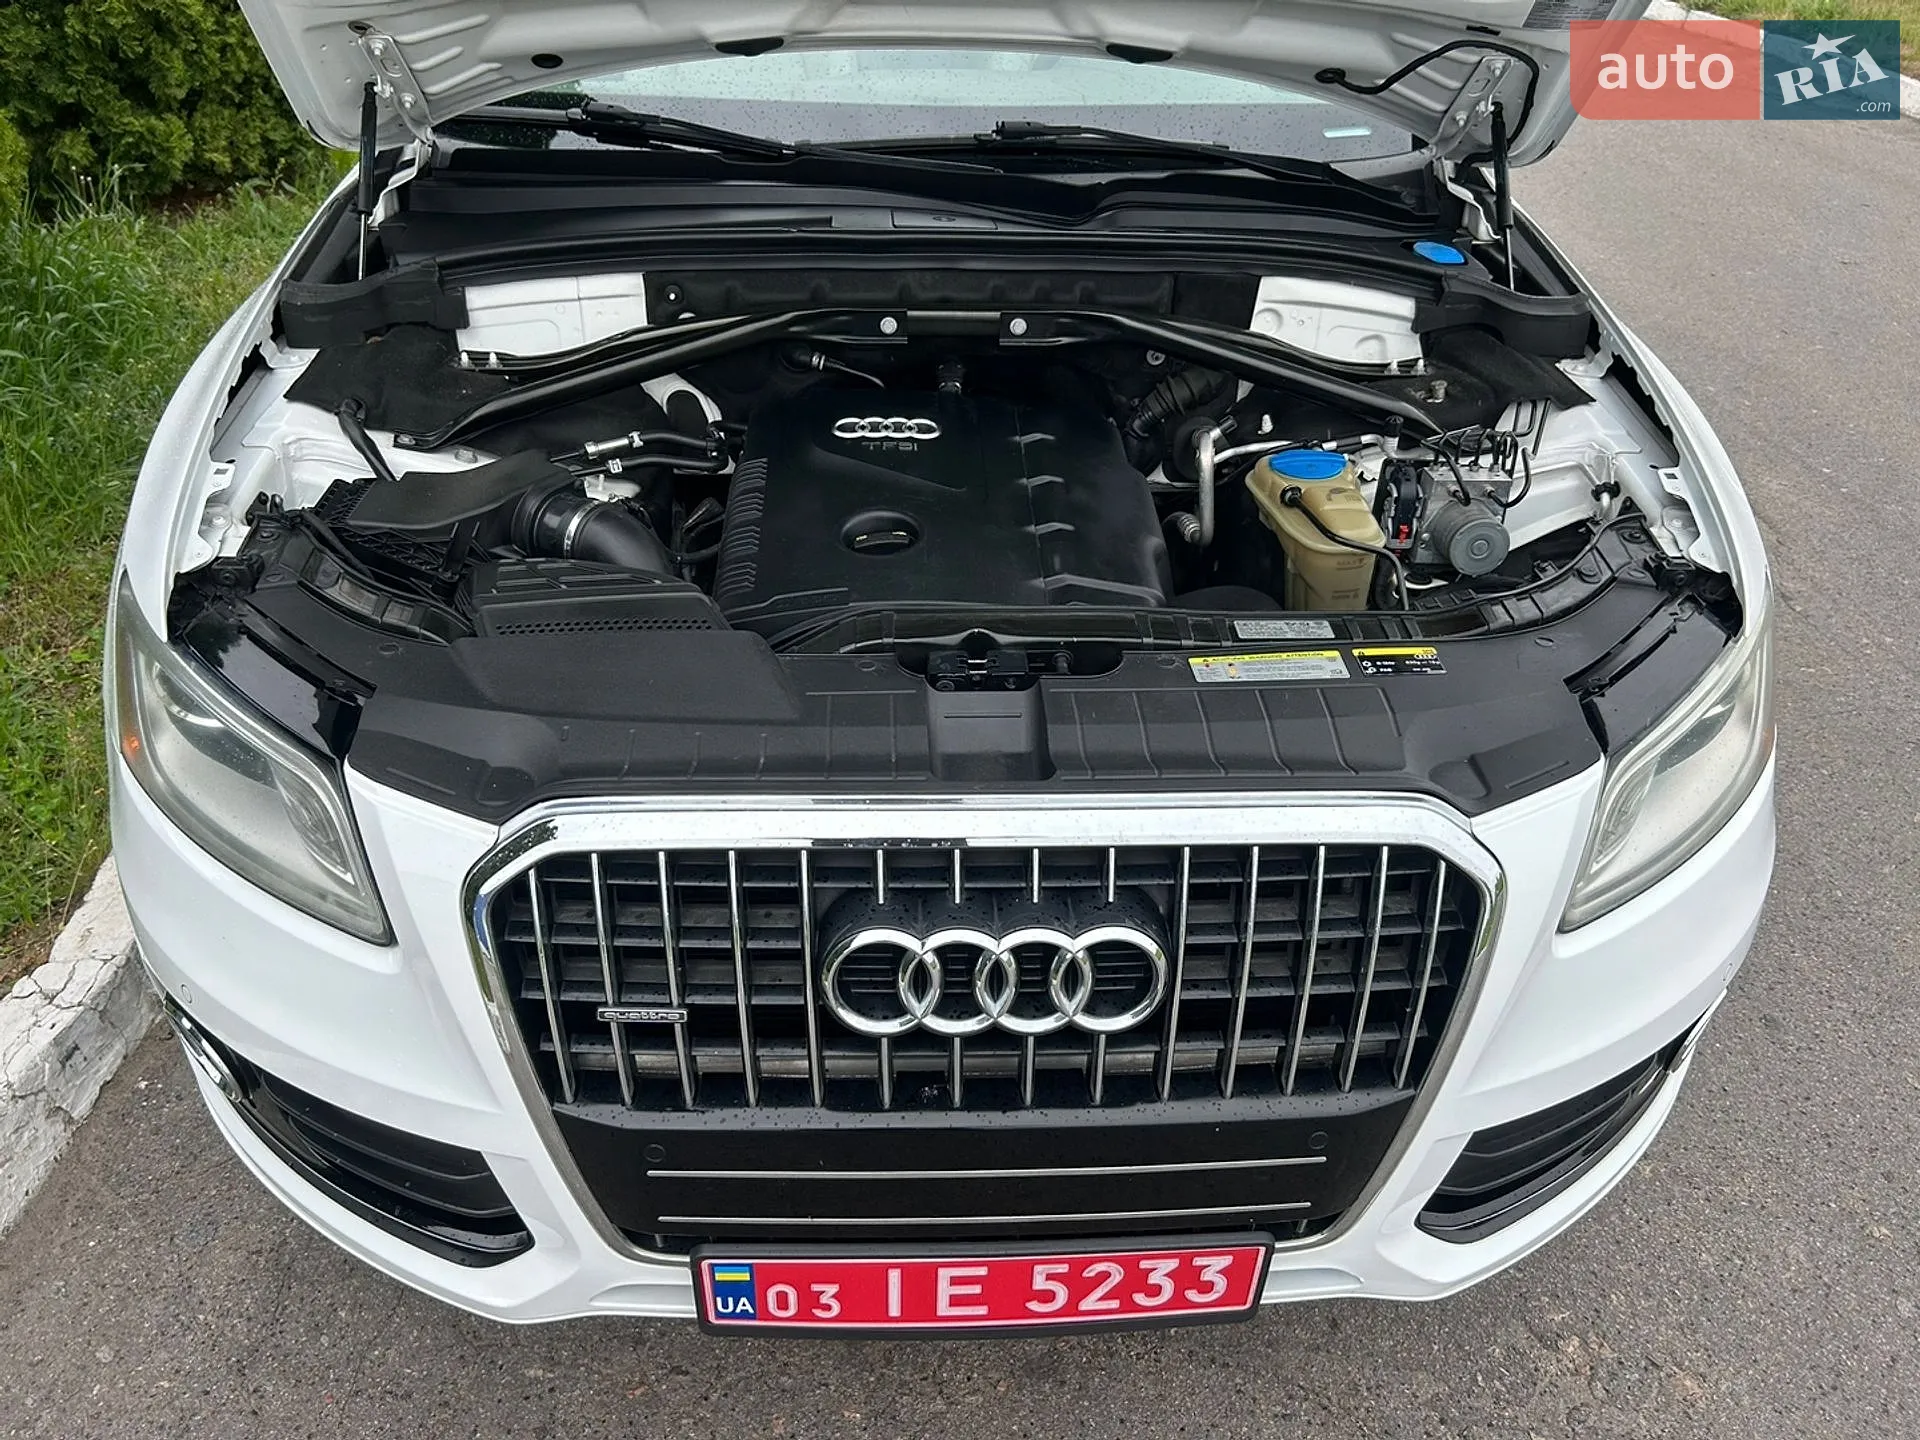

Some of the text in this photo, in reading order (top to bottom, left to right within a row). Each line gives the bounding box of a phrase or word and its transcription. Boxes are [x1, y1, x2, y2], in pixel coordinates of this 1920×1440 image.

[861, 441, 918, 451] TFSI
[603, 1011, 680, 1020] quattro
[766, 1256, 1234, 1318] 03 IE 5233
[716, 1296, 755, 1313] UA
